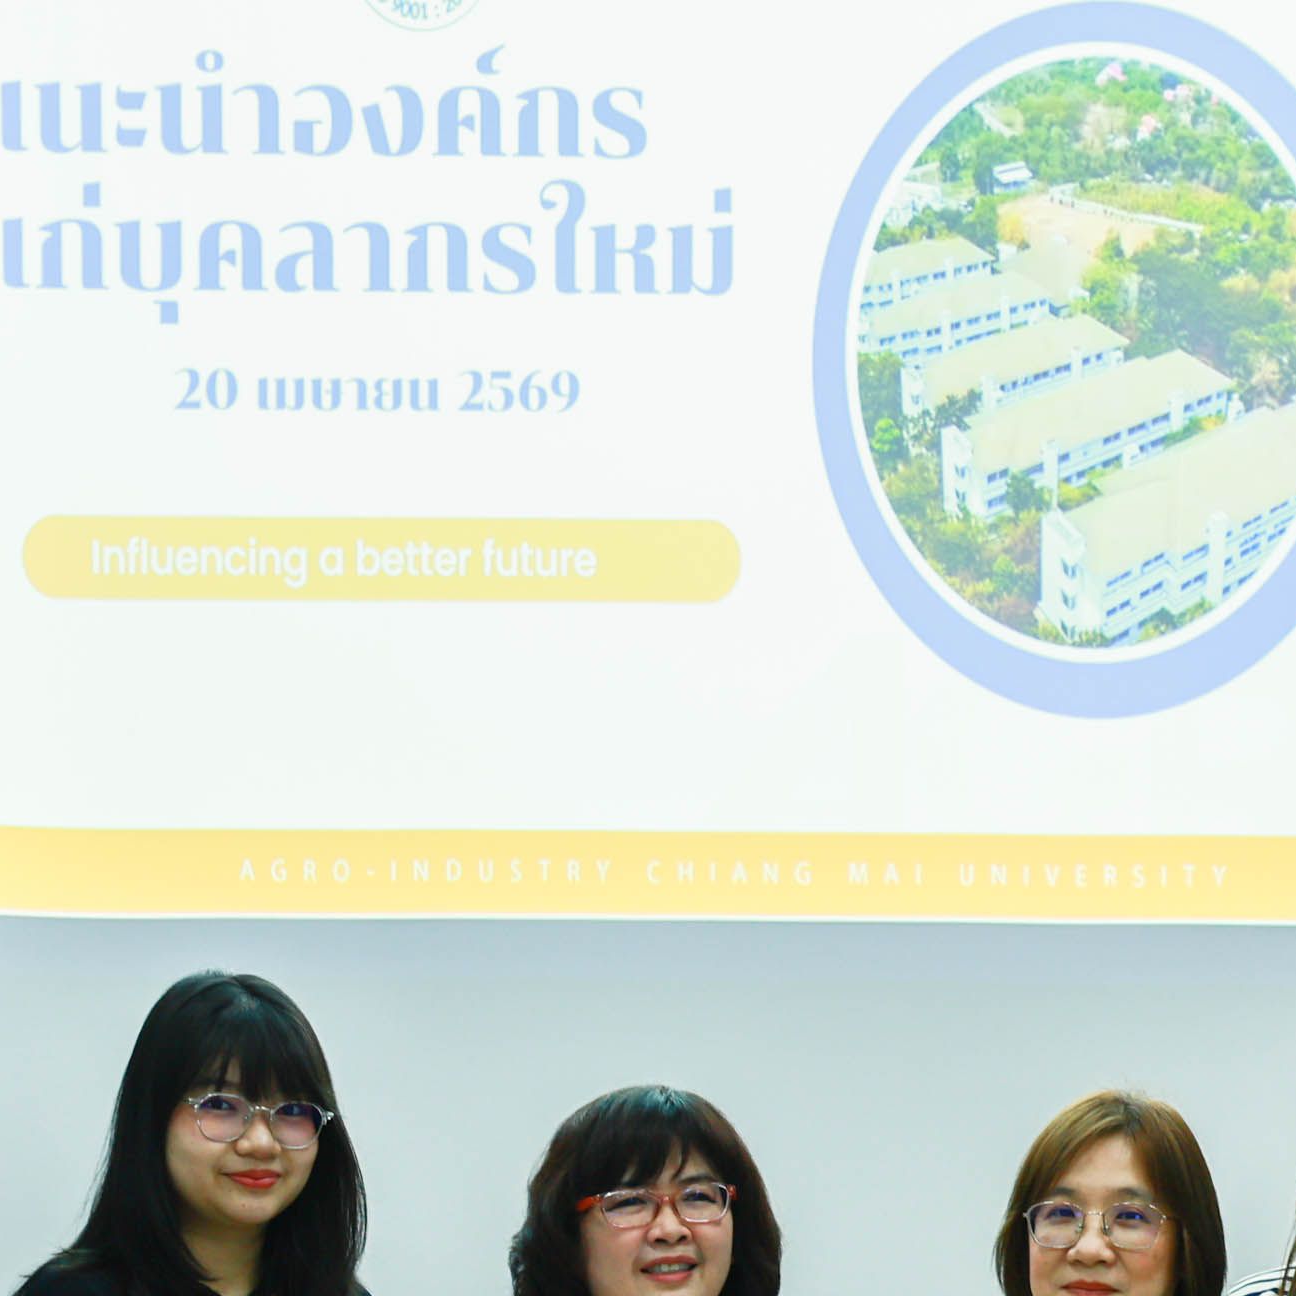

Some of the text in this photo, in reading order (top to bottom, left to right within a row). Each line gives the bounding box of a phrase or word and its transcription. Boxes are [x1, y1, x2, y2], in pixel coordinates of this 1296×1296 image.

[174, 367, 581, 413] 20 เมษายน 2569
[91, 537, 598, 587] Influencing a better future
[238, 857, 1229, 889] AGRO-INDUSTRY CHIANG MAI UNIVERSITY
